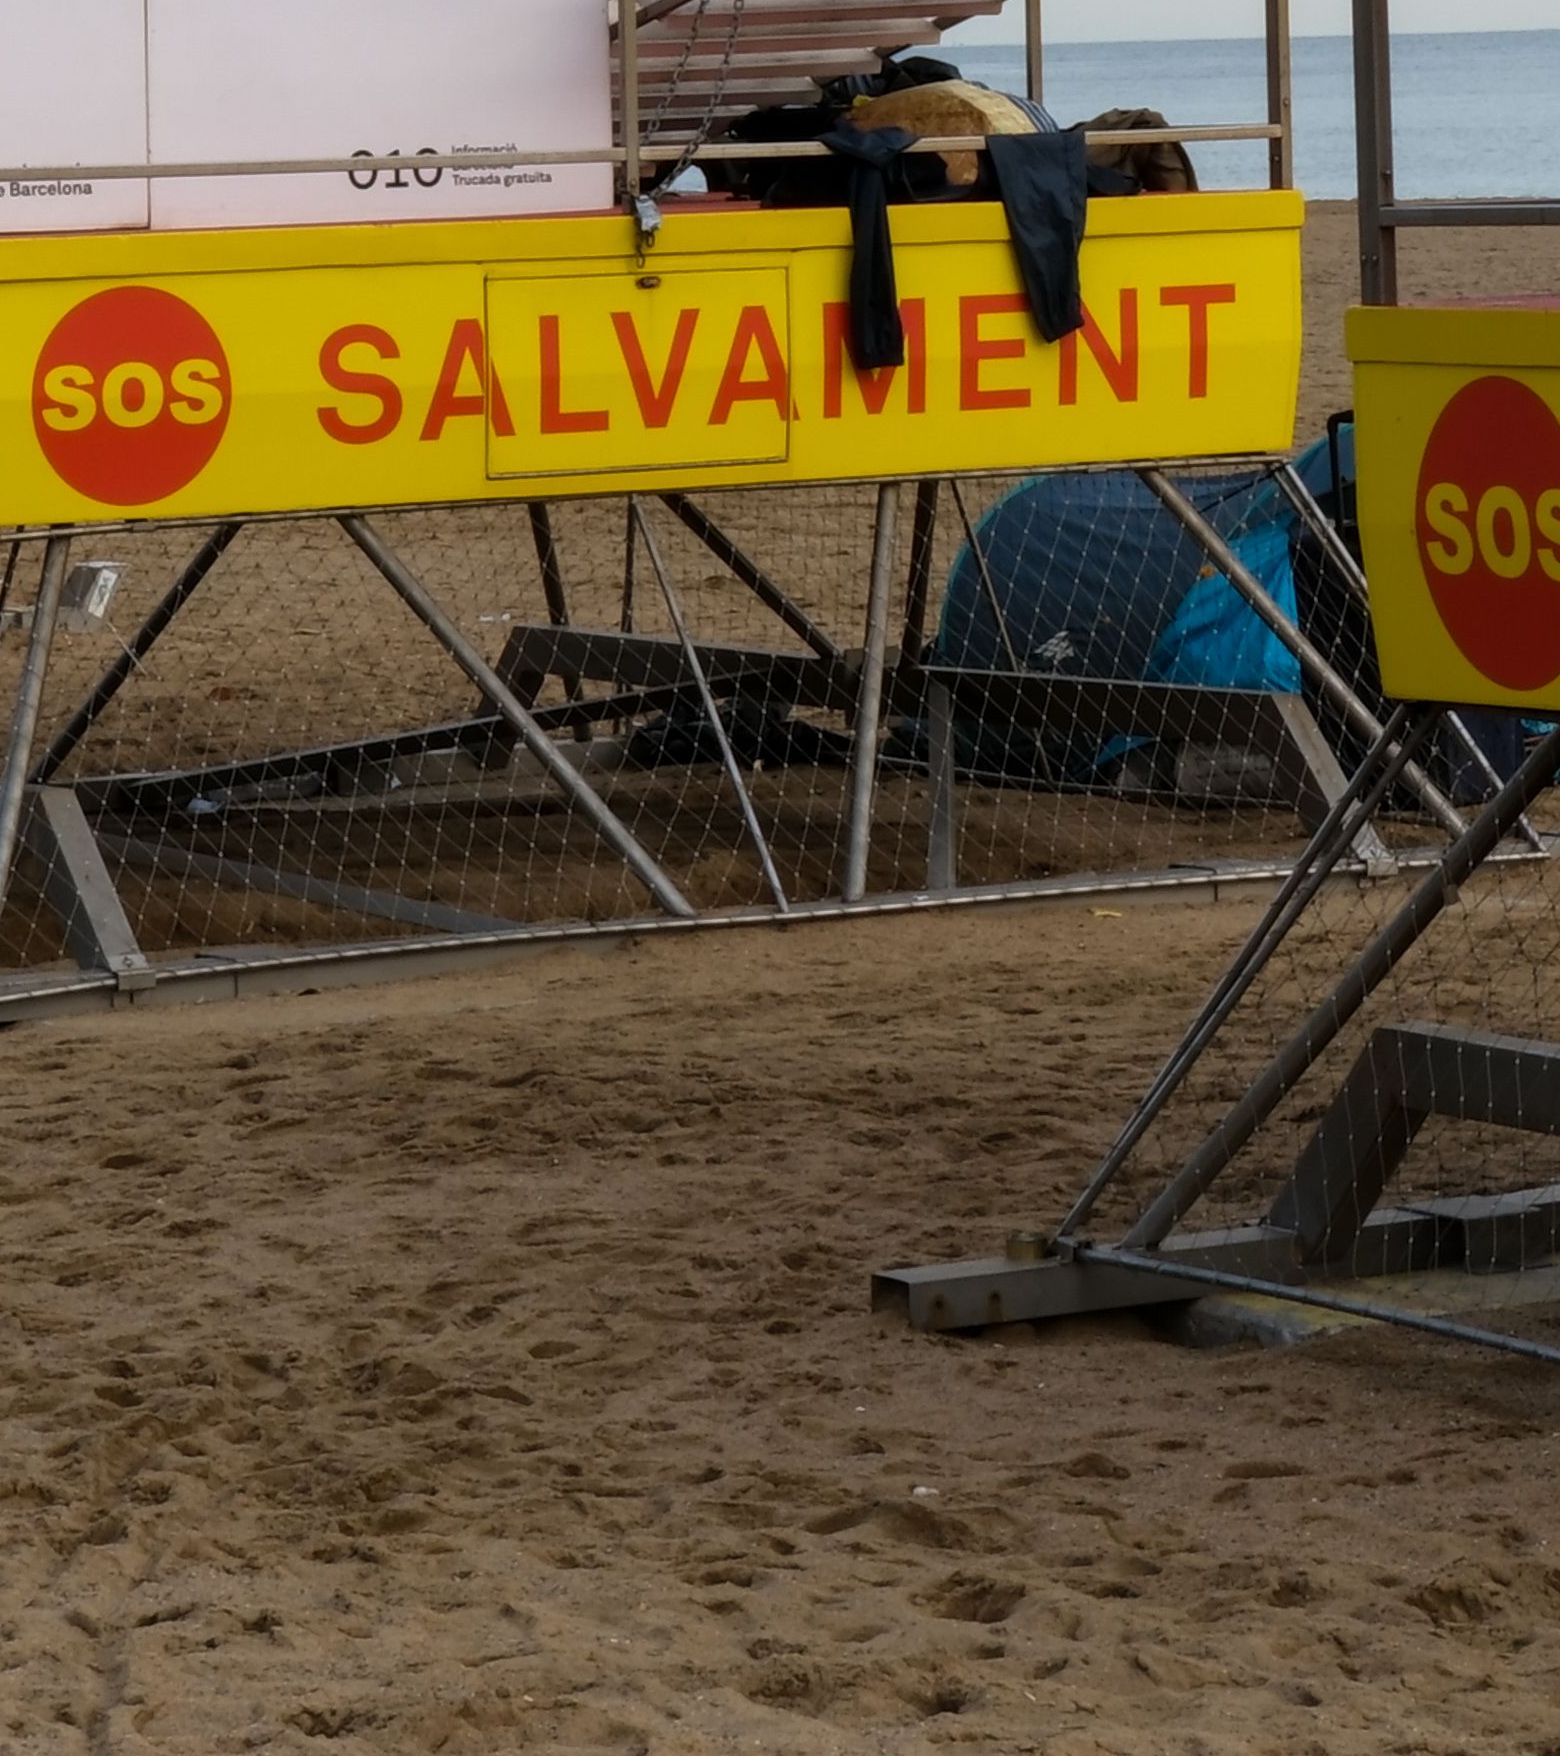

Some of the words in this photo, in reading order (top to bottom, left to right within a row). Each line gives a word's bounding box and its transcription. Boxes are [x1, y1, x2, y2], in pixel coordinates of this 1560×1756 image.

[9, 180, 93, 197] Barcelona
[348, 147, 443, 190] 010
[41, 359, 225, 432] SOS
[316, 283, 1238, 445] SALVAMENT
